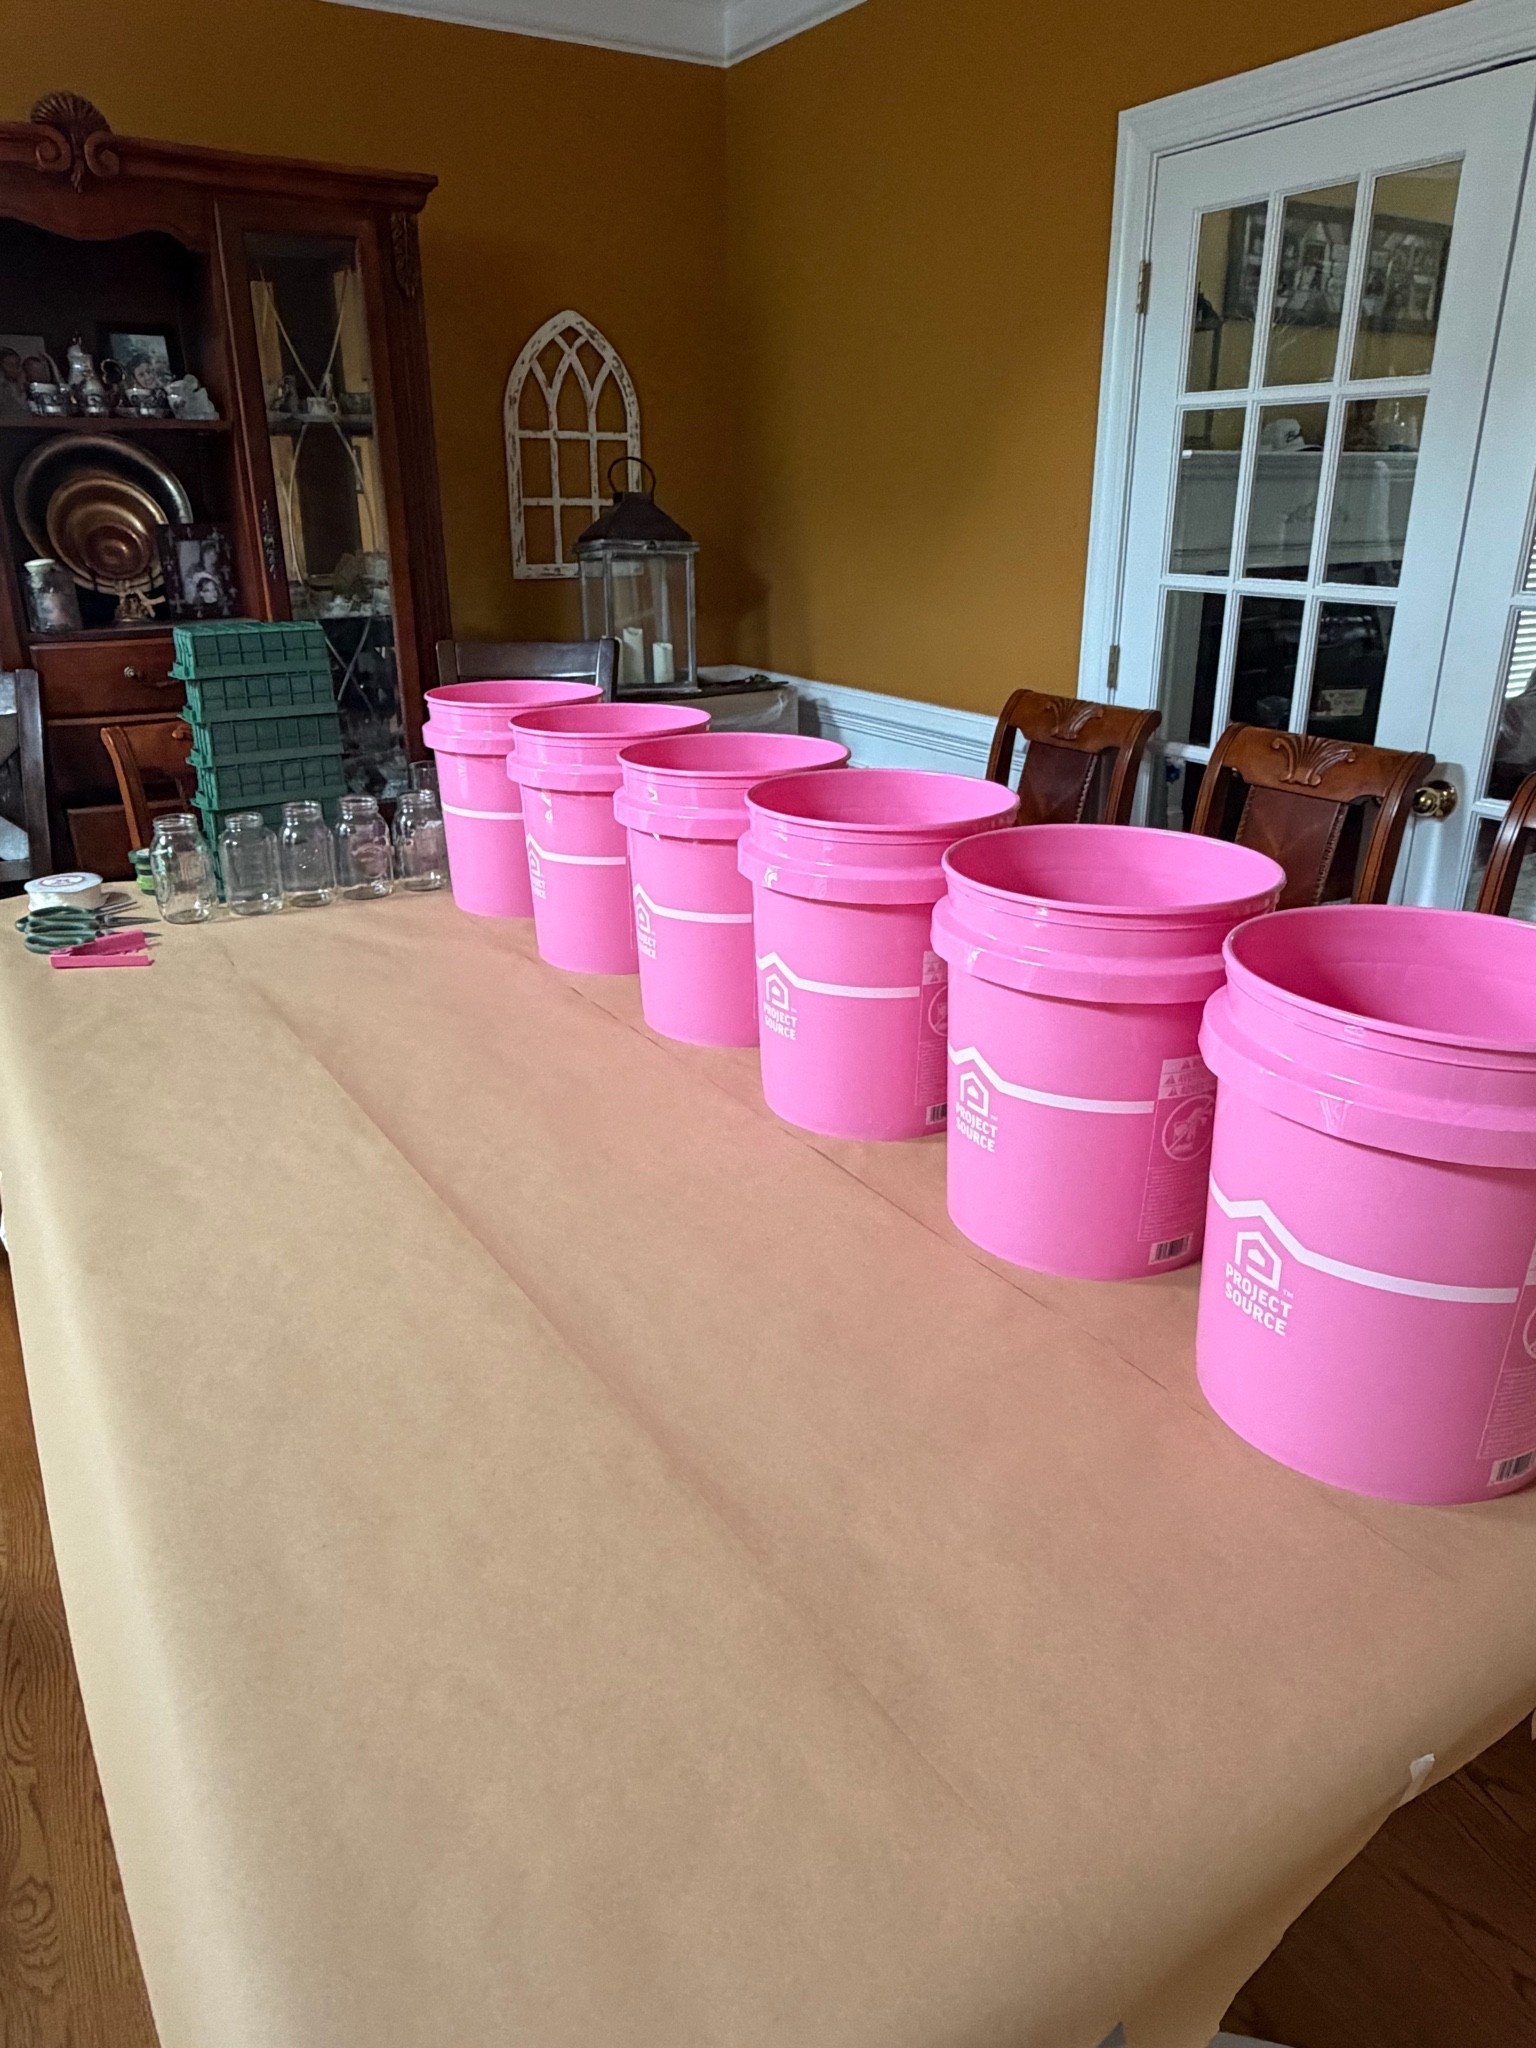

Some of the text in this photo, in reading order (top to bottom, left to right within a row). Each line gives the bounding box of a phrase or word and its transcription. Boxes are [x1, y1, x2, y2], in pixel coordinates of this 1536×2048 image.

[763, 1002, 796, 1027] PROJECT
[764, 1016, 796, 1040] SOURCE
[955, 1102, 998, 1138] PROJECT
[956, 1117, 995, 1152] SOURCE
[1225, 1262, 1293, 1317] PROJECT
[1225, 1283, 1286, 1336] SOURCE
